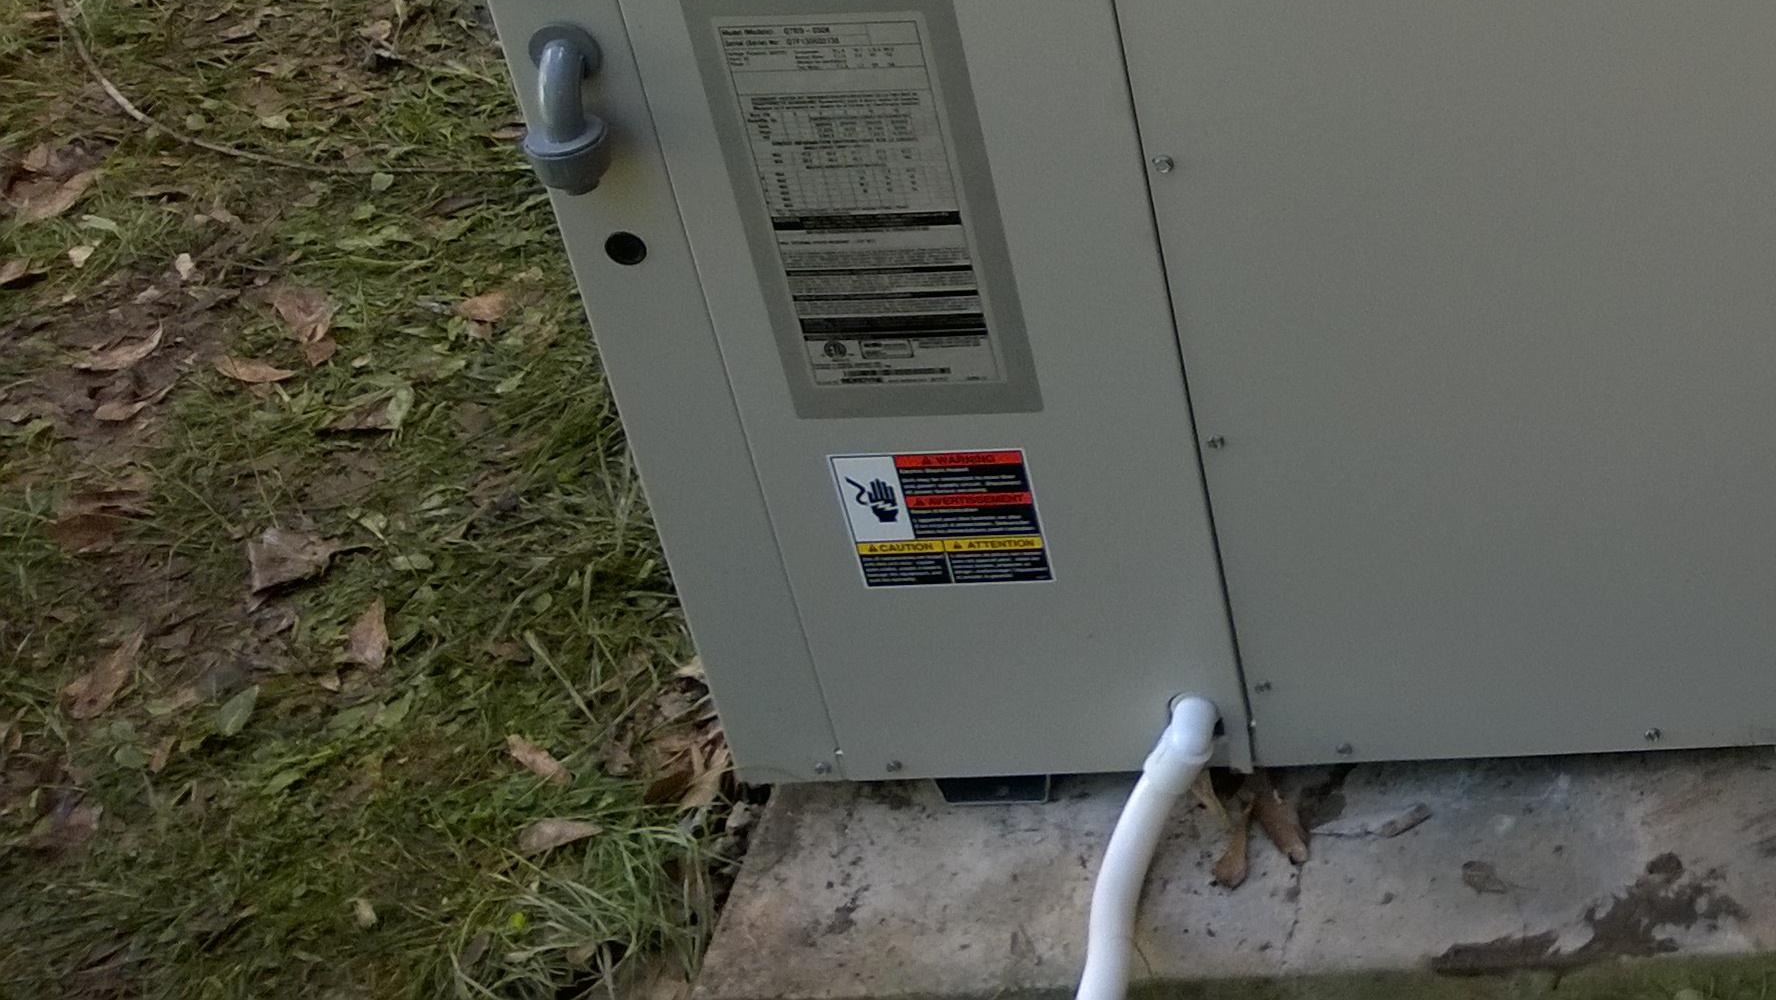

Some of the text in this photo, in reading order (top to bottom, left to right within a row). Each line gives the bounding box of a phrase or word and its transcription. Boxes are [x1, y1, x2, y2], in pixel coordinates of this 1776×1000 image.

[936, 454, 996, 465] WARNING
[928, 494, 1024, 506] AVERTISSEMENT
[879, 542, 934, 553] CAUTION
[967, 538, 1035, 549] ATTENTION
